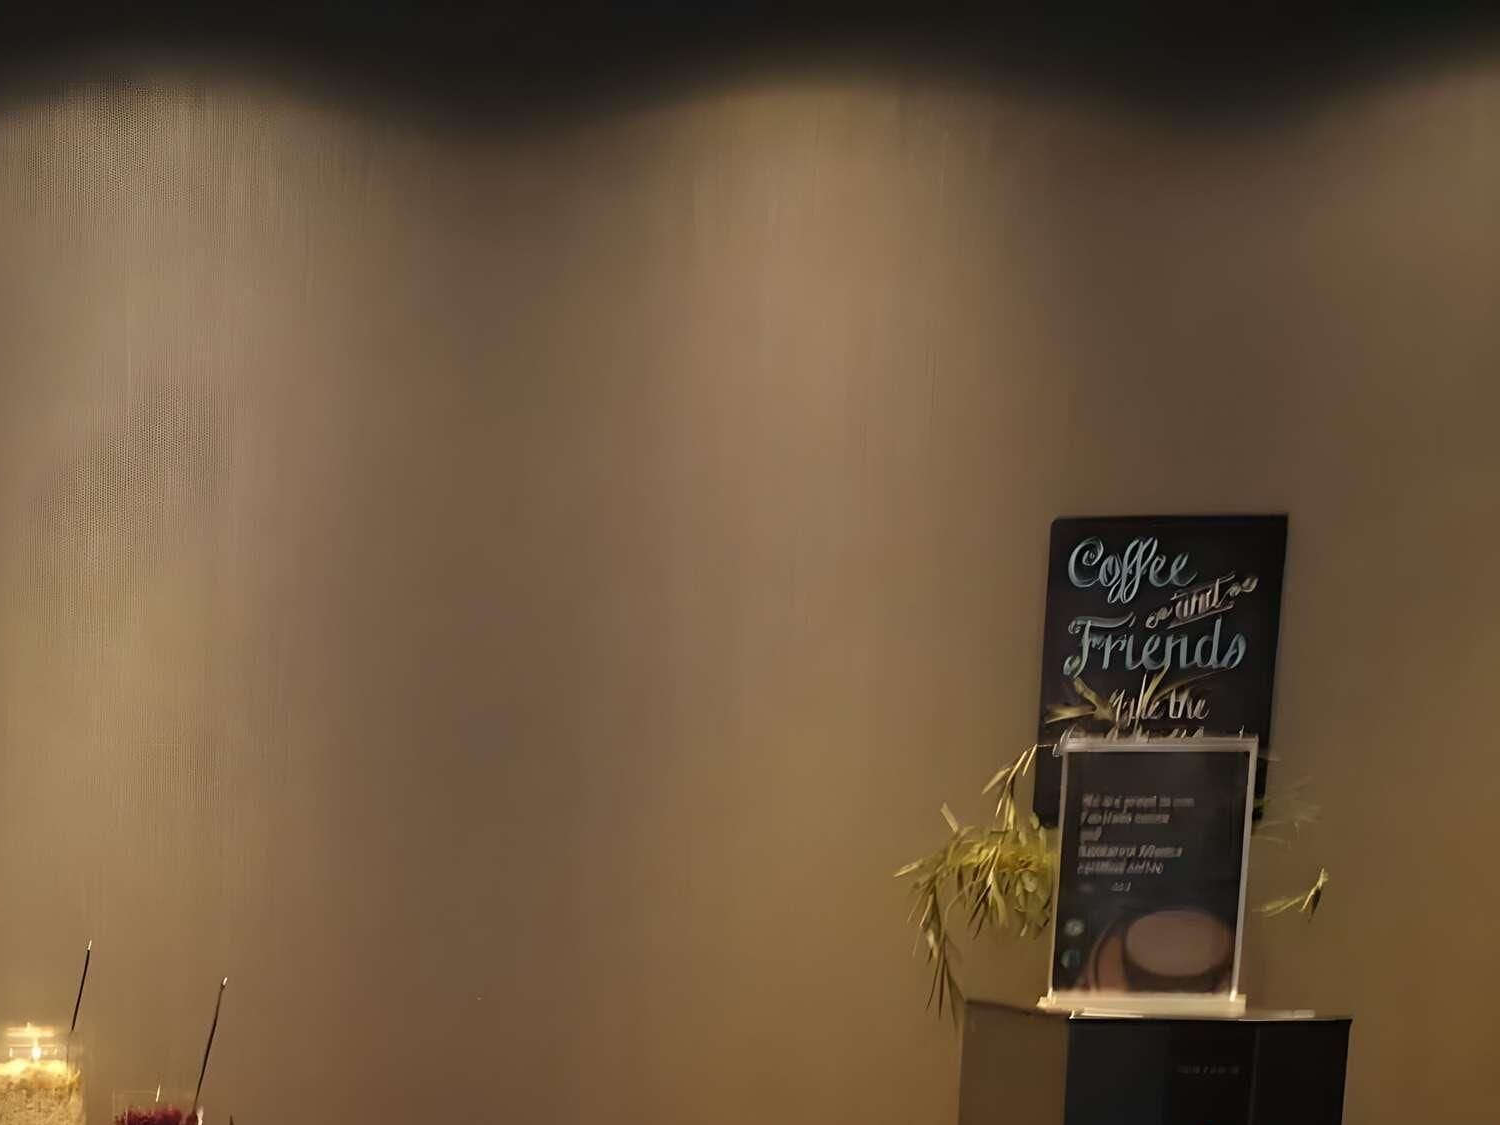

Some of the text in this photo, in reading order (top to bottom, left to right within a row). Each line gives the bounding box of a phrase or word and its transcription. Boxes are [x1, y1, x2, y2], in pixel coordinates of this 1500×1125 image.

[1068, 537, 1198, 604] Coffee
[1175, 577, 1222, 620] and
[1063, 611, 1247, 678] Friends
